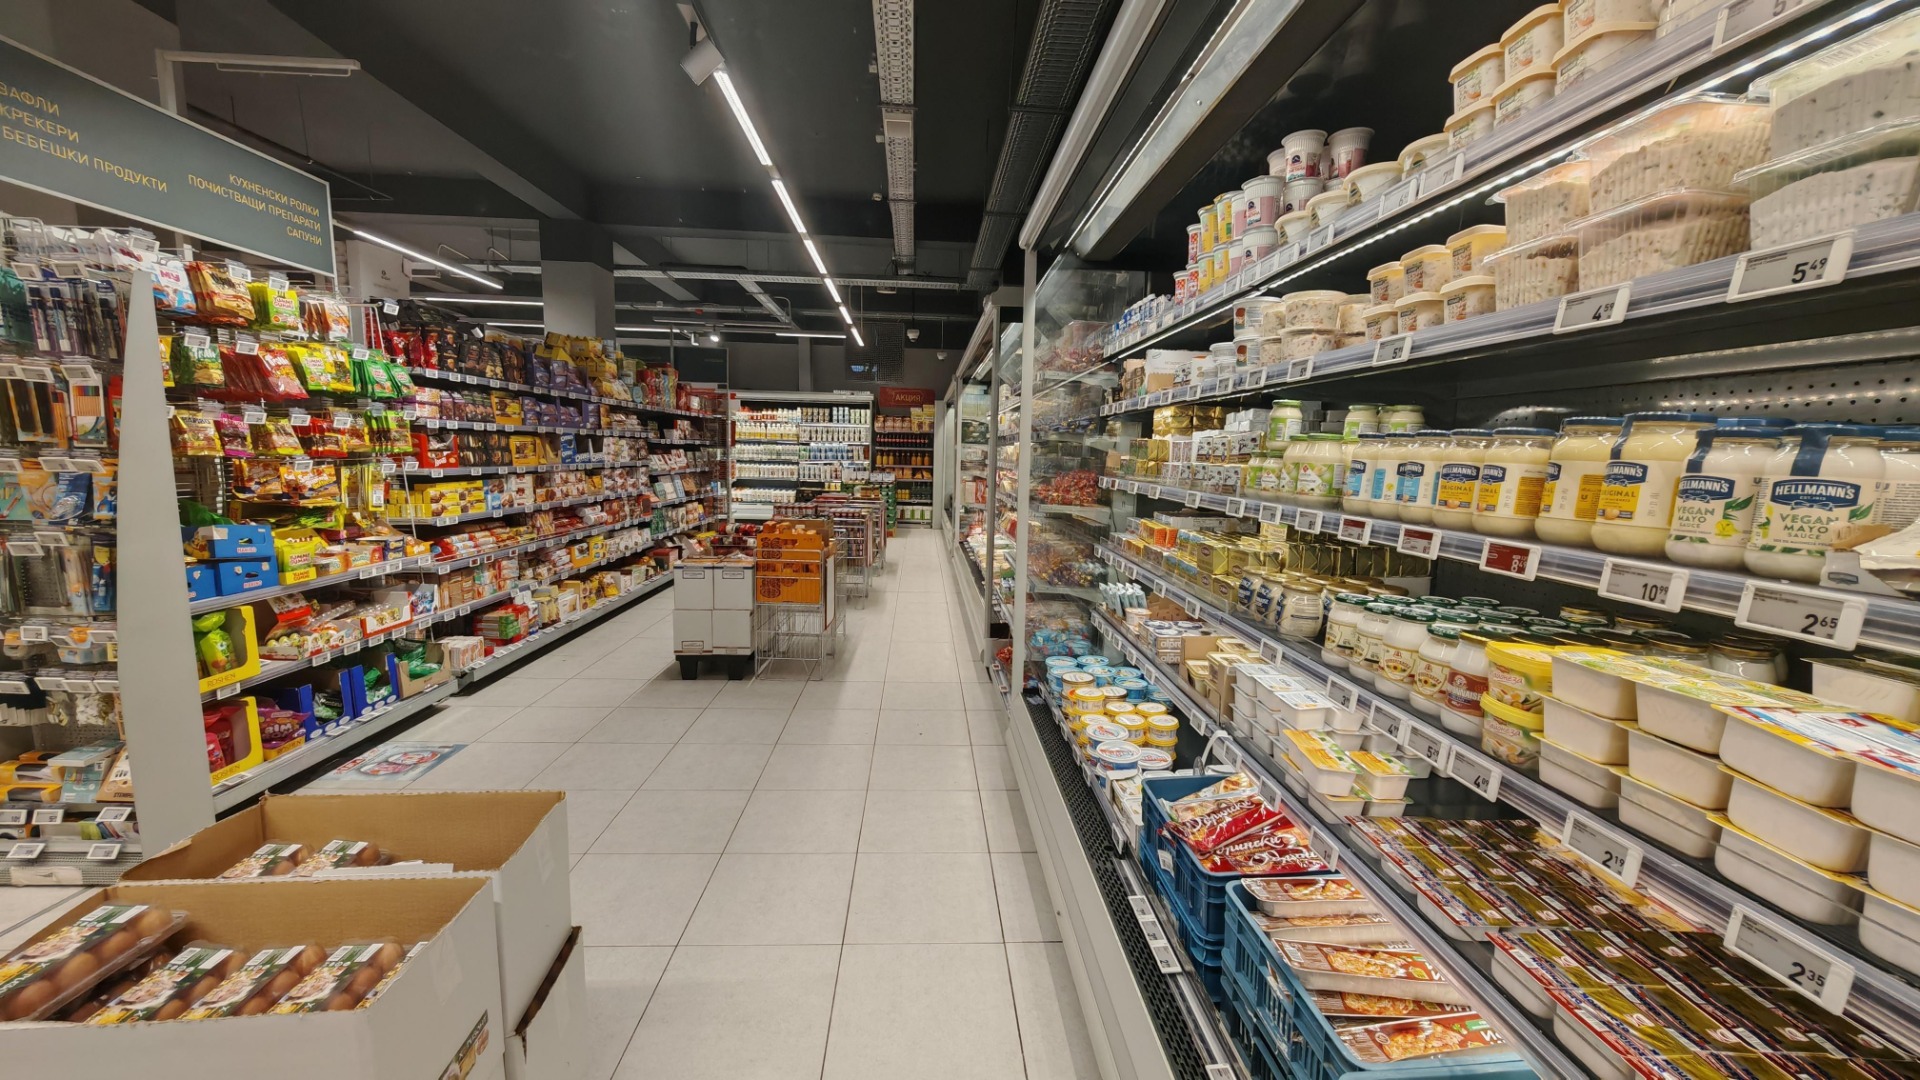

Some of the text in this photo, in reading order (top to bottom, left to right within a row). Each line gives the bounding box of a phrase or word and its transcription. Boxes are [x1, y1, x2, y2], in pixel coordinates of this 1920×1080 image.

[0, 104, 79, 143] КРЕКЕРИ
[3, 126, 167, 192] БЕБЕШКИ ПРОДУКТИ
[230, 174, 319, 216] КУХНЕНСКИ РОЛКИ
[188, 174, 320, 231] ПОЧИСТВАЩИ ПРЕПАРАТИ
[287, 226, 322, 245] САПУНИ
[895, 394, 921, 402] АКЦИЯ
[1775, 484, 1855, 499] HELLMANN'S
[1678, 507, 1715, 516] VEGAN
[1678, 515, 1706, 523] MAYO
[1780, 513, 1839, 525] VEGAN
[1783, 524, 1828, 533] MAYO
[207, 673, 236, 687] ROSHEN
